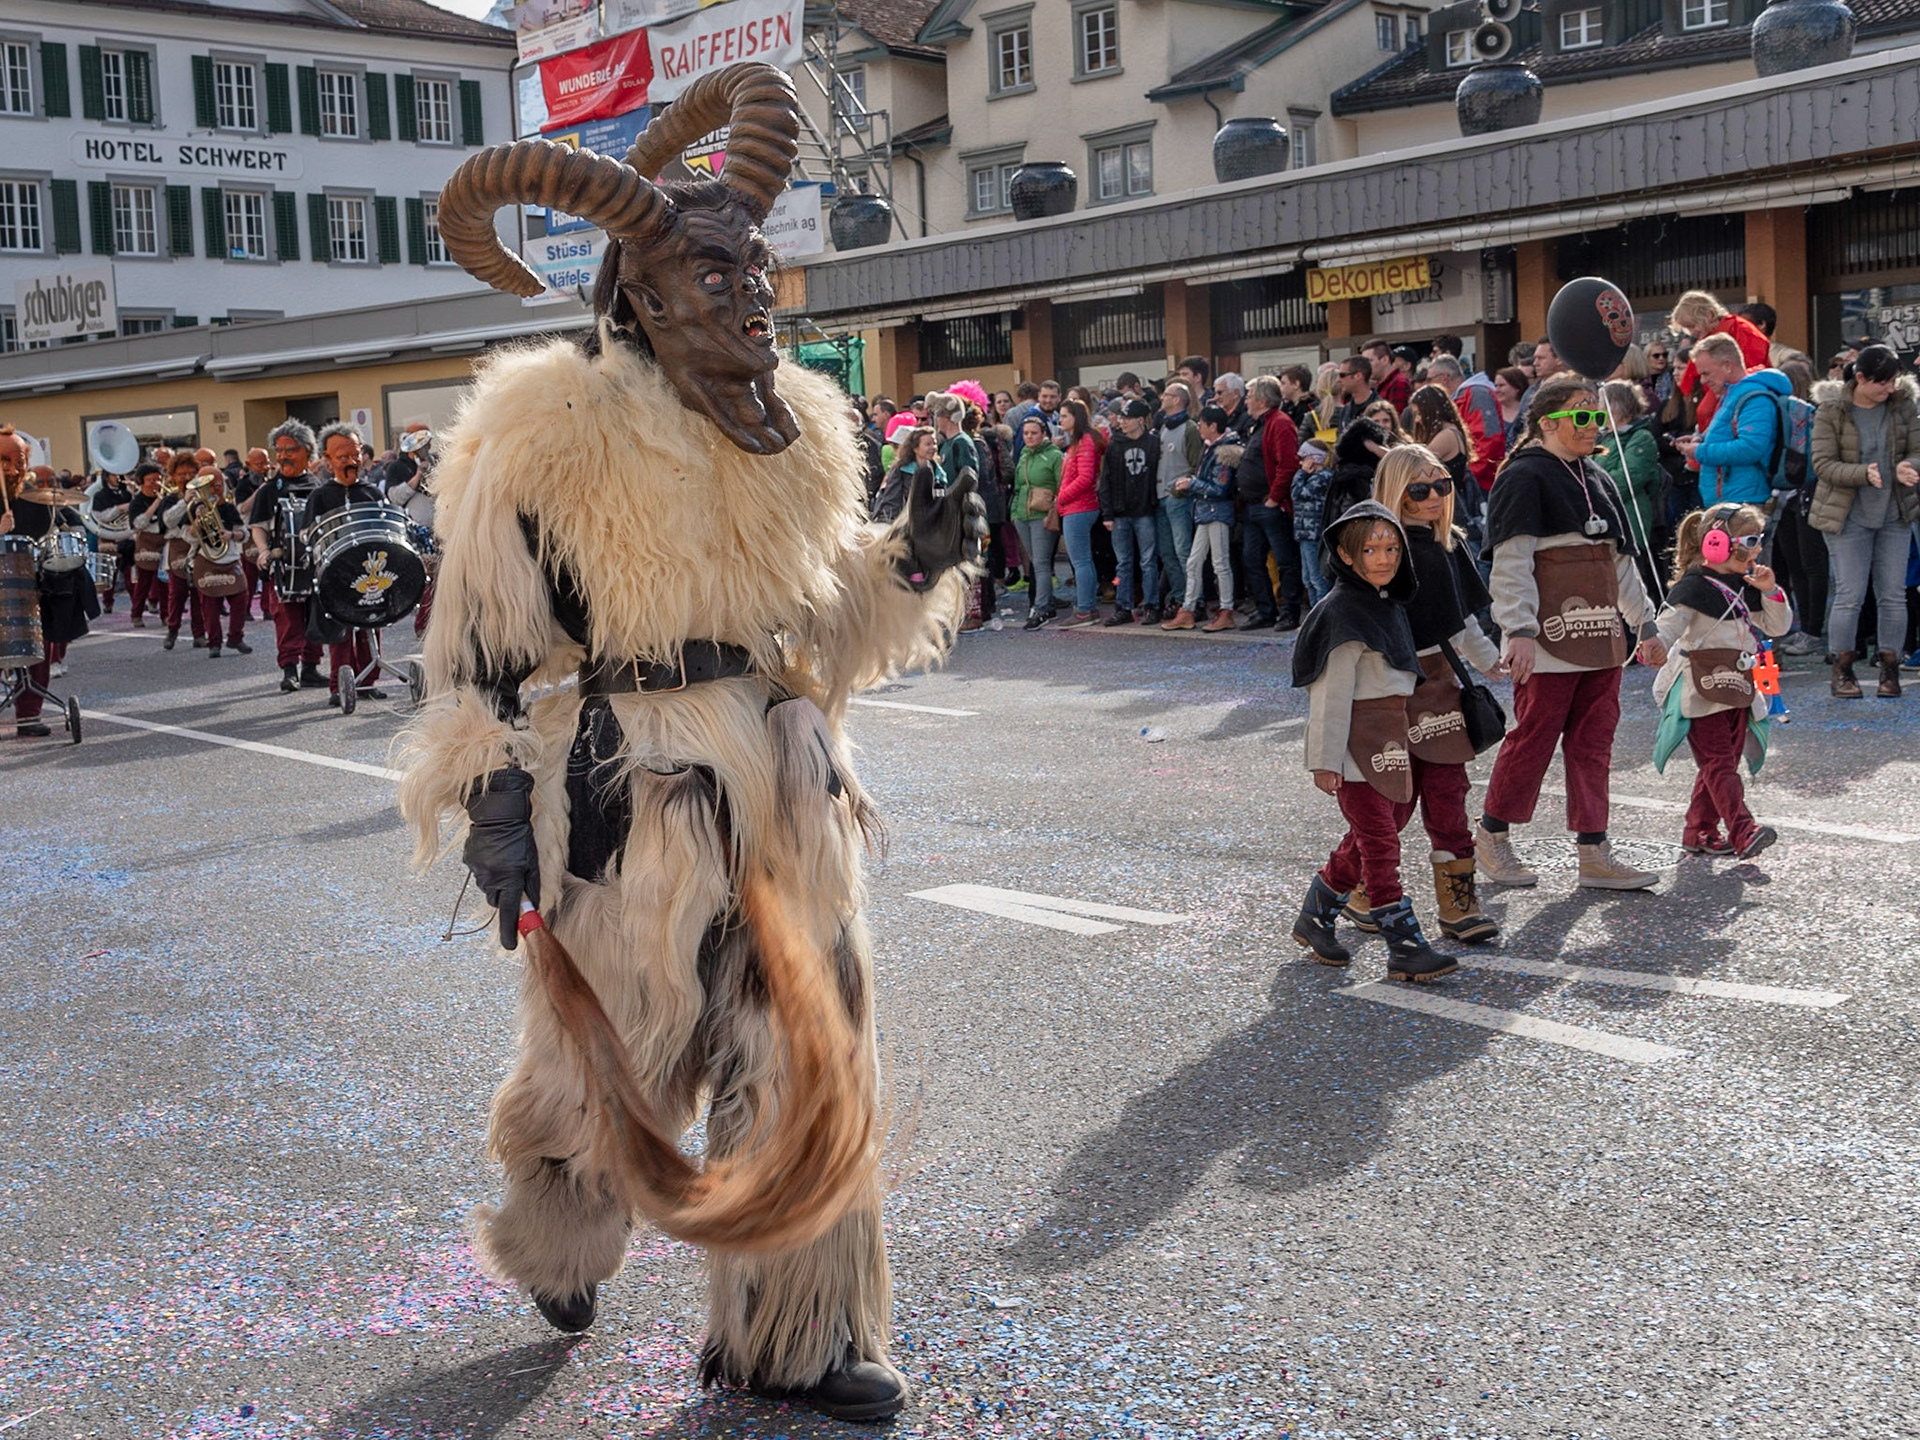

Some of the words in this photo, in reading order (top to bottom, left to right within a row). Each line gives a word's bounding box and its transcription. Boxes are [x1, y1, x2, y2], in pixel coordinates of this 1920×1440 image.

[660, 12, 792, 80] RAIFFEISEN
[559, 66, 611, 95] WUNDERLE
[85, 139, 162, 163] HOTEL
[179, 145, 287, 171] SCHWERT
[801, 217, 816, 231] ag
[546, 240, 592, 261] Stüssi
[547, 269, 590, 289] Näfels
[1309, 256, 1427, 299] Dekoriert
[24, 275, 106, 332] schubiger
[1881, 305, 1920, 323] BIS
